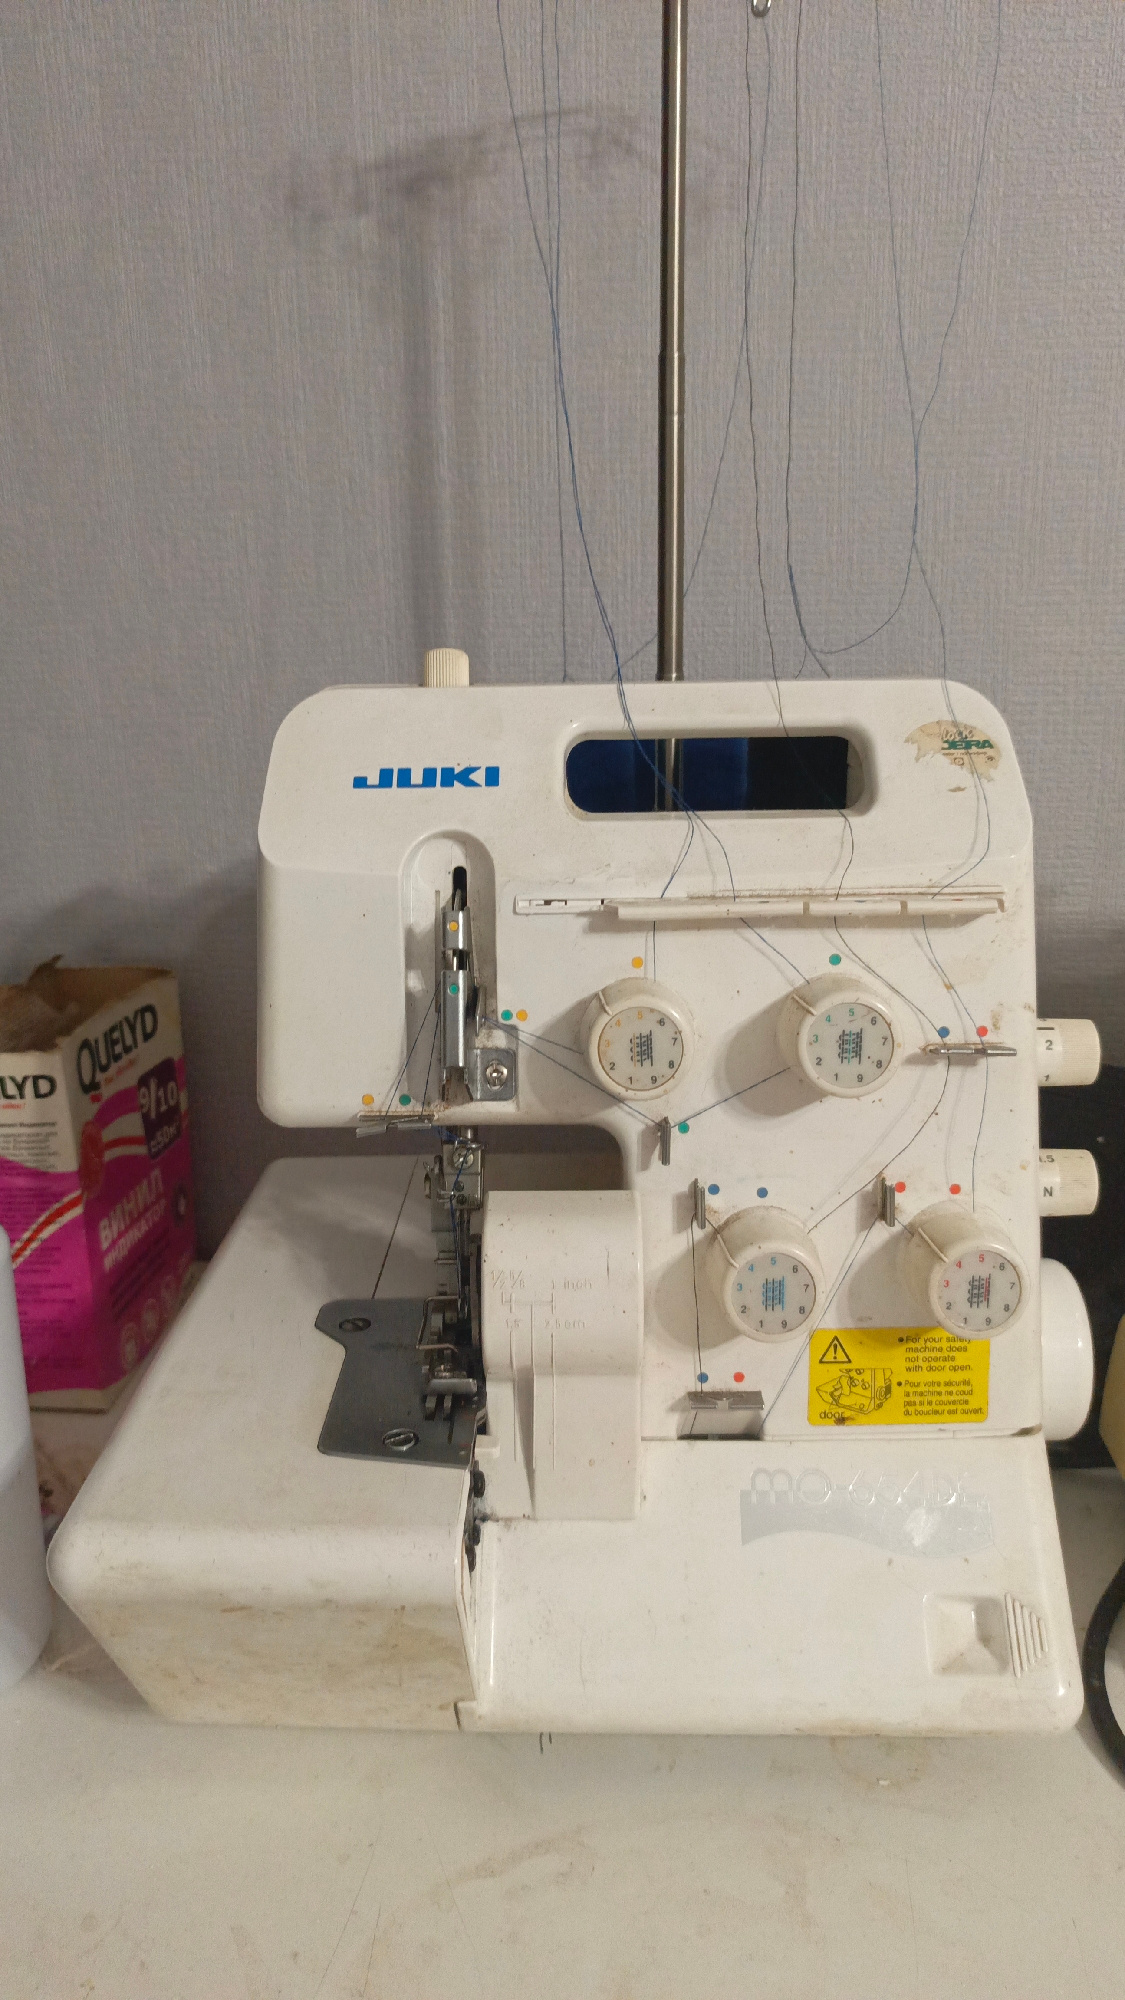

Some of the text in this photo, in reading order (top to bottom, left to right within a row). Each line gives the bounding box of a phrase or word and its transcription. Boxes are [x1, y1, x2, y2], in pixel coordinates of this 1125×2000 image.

[353, 766, 499, 789] JUKI
[77, 1004, 158, 1094] QUELYD
[1045, 1039, 1053, 1050] 2
[1043, 1186, 1053, 1197] N
[906, 1336, 920, 1344] For
[924, 1336, 942, 1345] your
[905, 1344, 943, 1353] machine
[922, 1355, 955, 1363] operate
[926, 1364, 945, 1372] door
[948, 1364, 973, 1372] open.
[912, 1389, 942, 1397] machine
[955, 1388, 973, 1396] coud
[904, 1400, 916, 1408] pas
[819, 1410, 845, 1419] door
[904, 1408, 912, 1416] du
